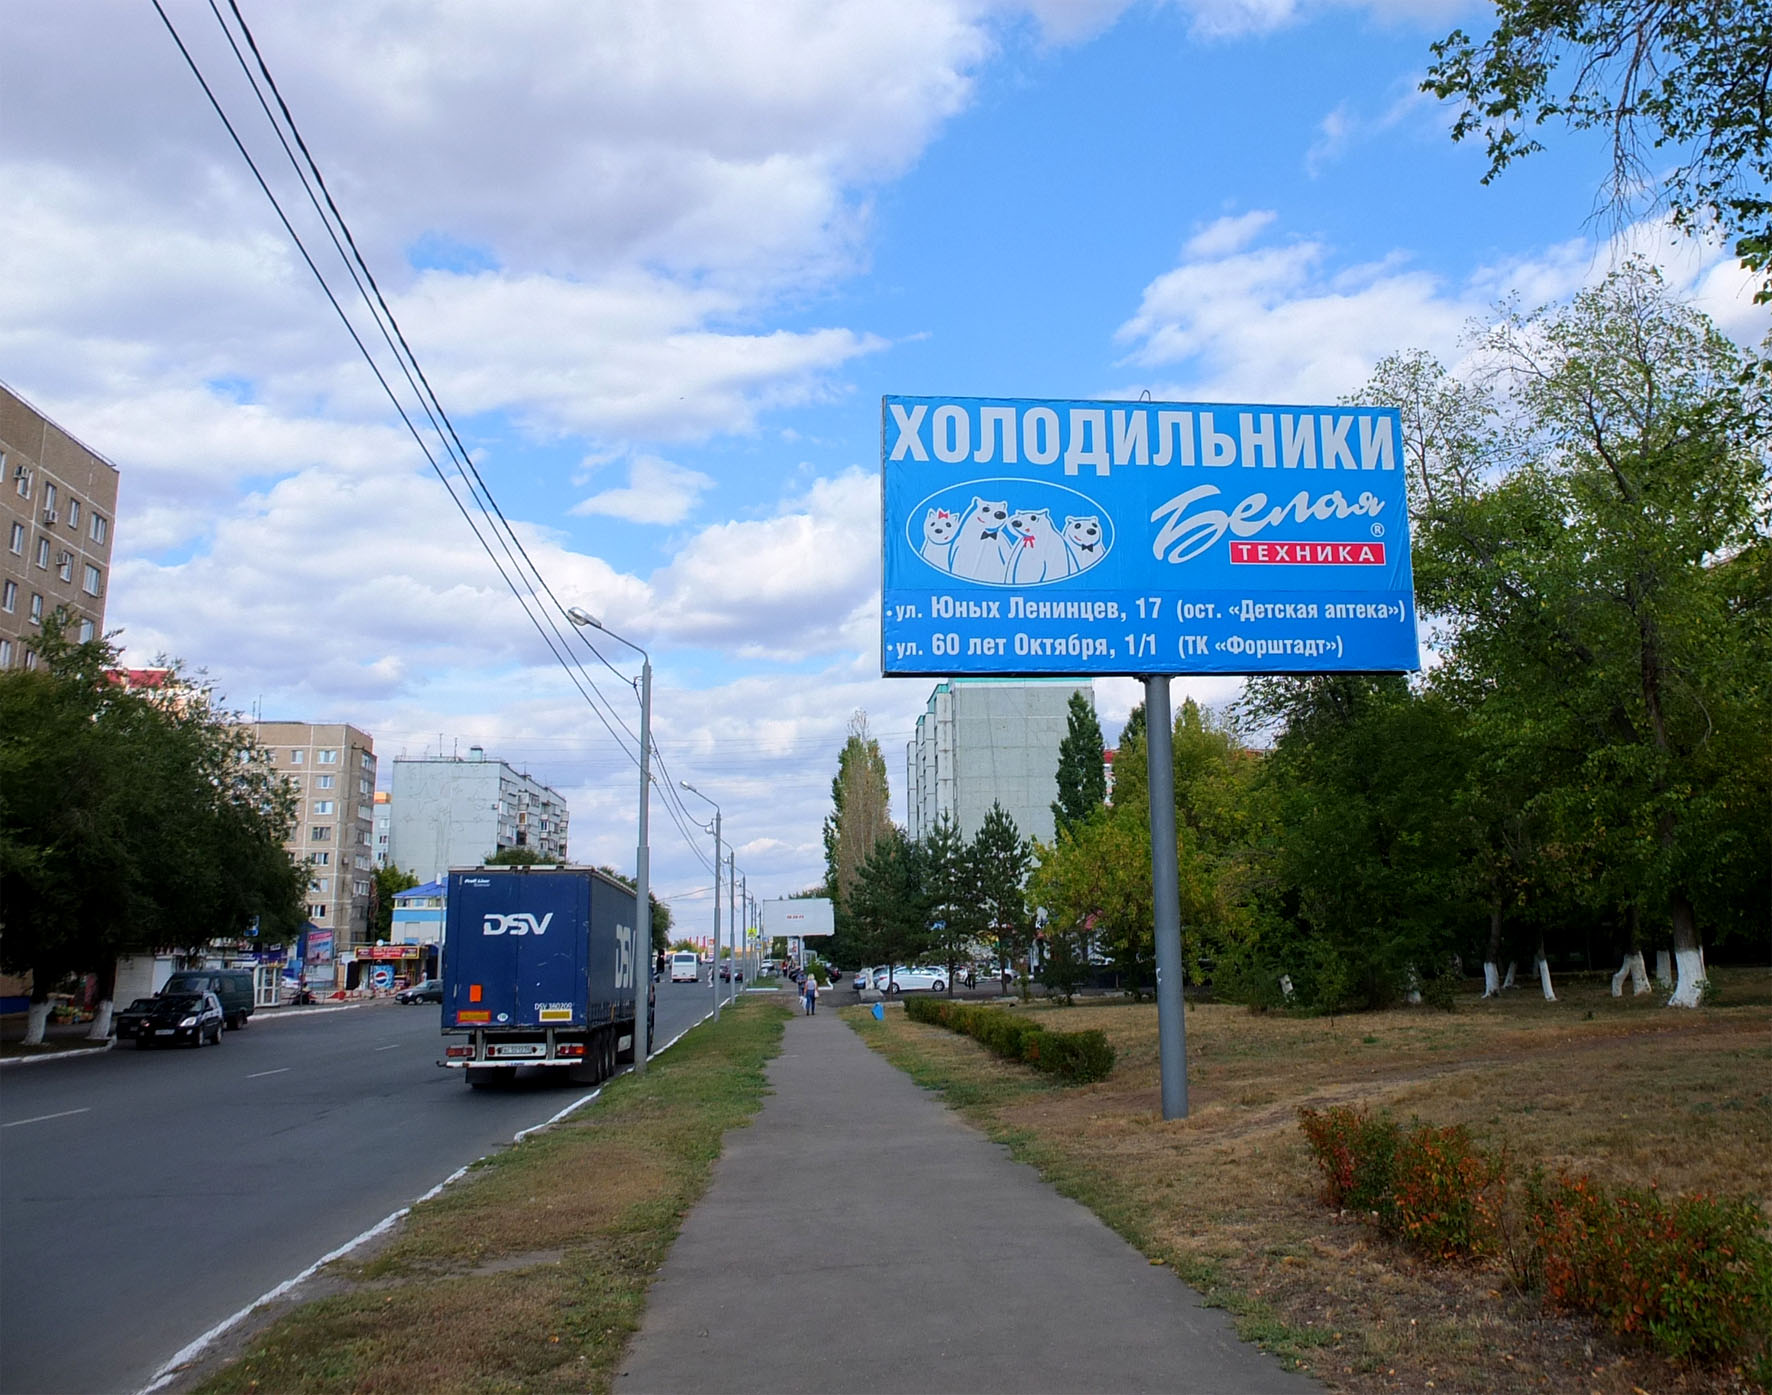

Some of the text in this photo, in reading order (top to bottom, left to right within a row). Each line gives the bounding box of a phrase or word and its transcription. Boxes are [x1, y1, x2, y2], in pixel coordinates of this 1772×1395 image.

[888, 404, 1396, 476] ХОЛОДИЛЬНИКИ
[1151, 484, 1386, 564] Белая
[1238, 544, 1375, 562] ТЕХНИКА
[931, 596, 1001, 619] Юных
[1008, 597, 1127, 622] Ленинцев,
[1136, 597, 1162, 619] 17
[1176, 600, 1222, 622] (ост.
[1228, 600, 1319, 622] «Детская
[1325, 600, 1406, 622] аптека»)
[931, 633, 960, 656] 60
[967, 640, 1007, 656] лет
[1014, 633, 1116, 660] Октября,
[1125, 634, 1157, 657] 1/1
[1178, 635, 1209, 659] (ТК
[1215, 635, 1343, 659] «Форштадт»)
[483, 912, 554, 936] DSV
